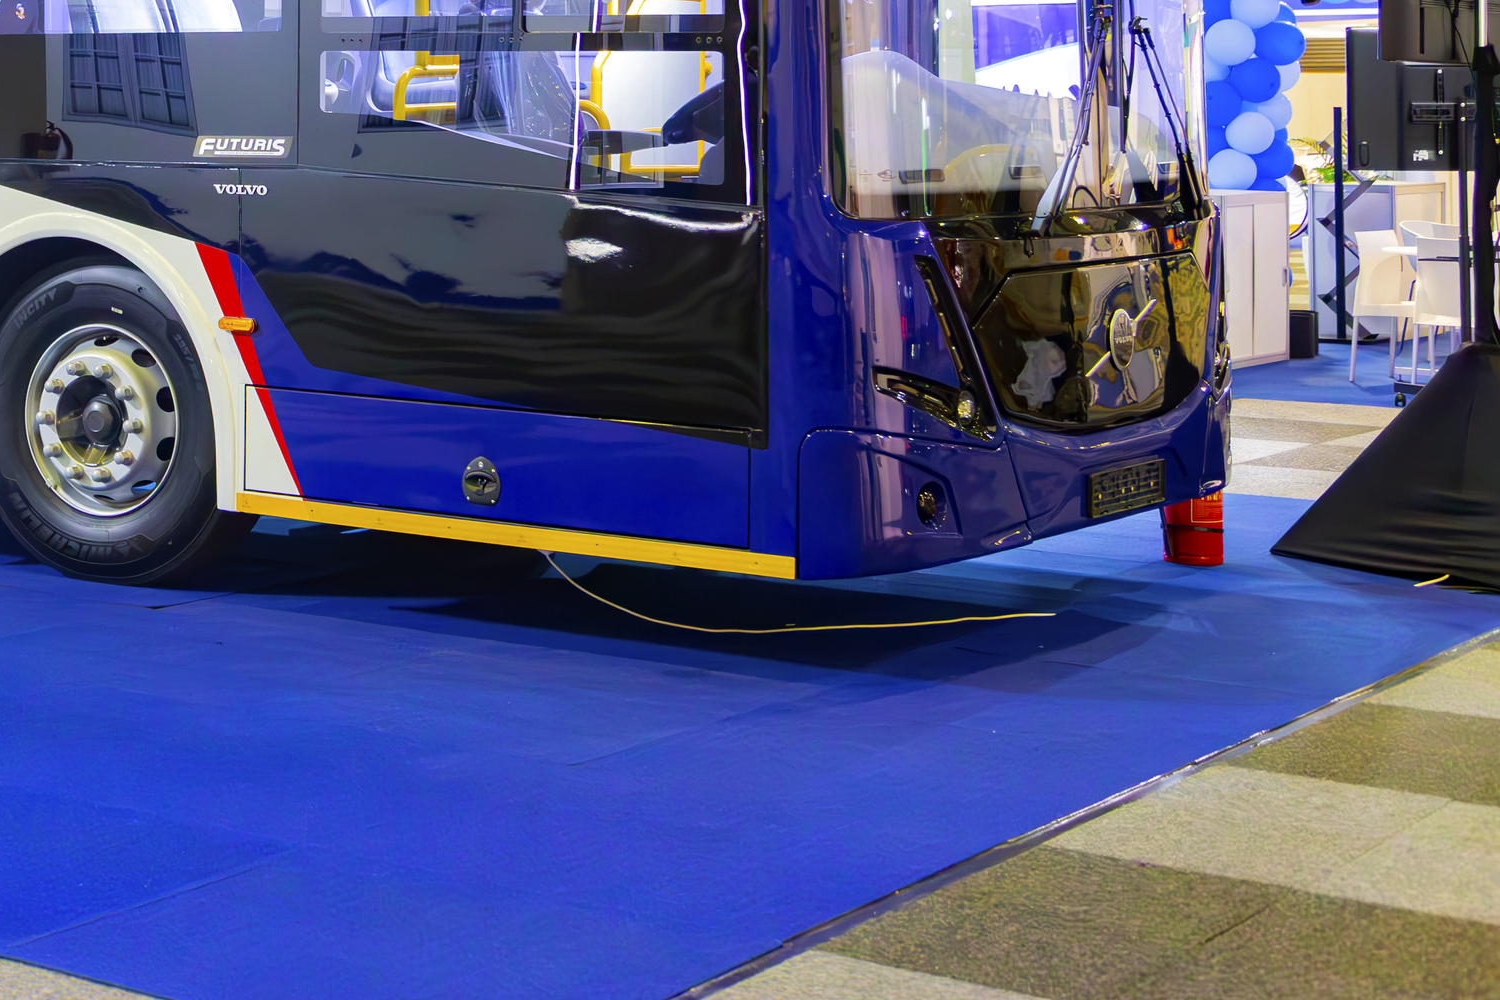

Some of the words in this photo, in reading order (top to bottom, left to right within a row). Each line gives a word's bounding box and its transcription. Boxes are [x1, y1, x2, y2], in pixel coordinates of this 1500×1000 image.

[198, 138, 286, 156] FUTURIS
[213, 184, 268, 196] VOLVO
[8, 491, 113, 560] MICHELIN
